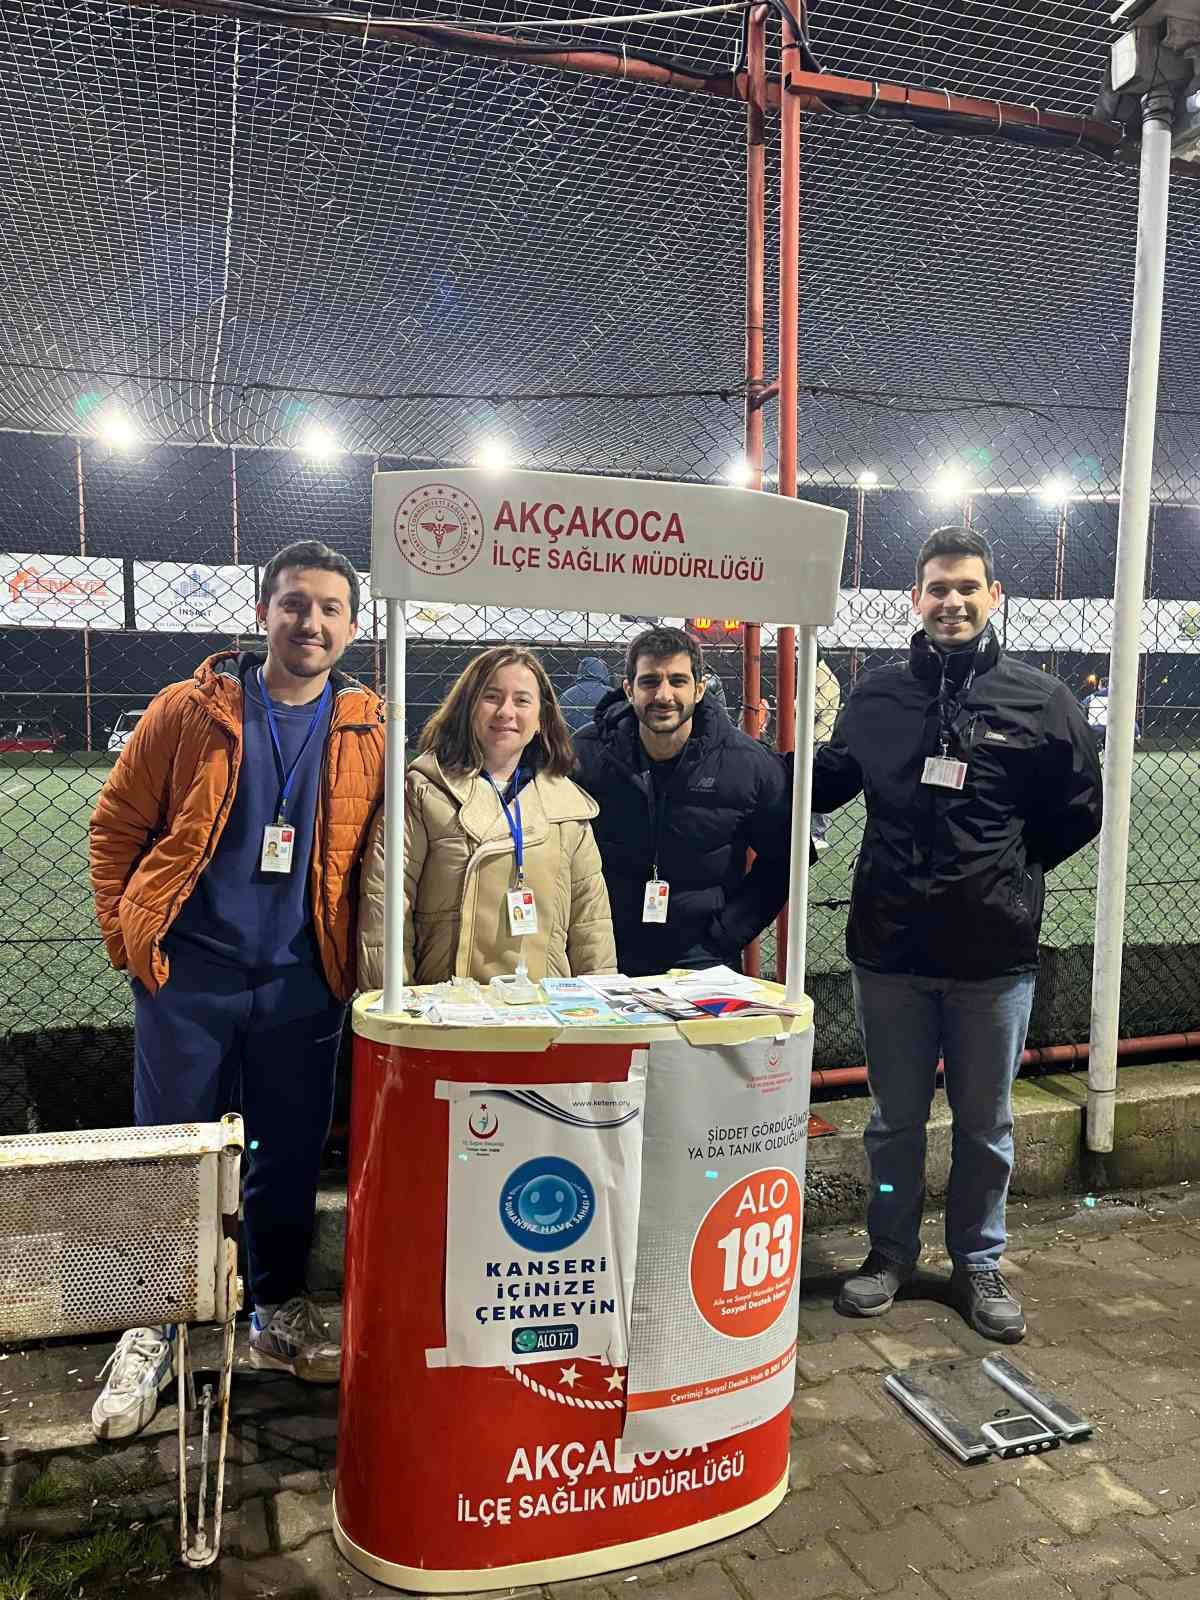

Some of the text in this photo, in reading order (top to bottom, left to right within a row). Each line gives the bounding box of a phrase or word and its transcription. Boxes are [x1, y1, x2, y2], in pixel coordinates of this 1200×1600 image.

[493, 500, 686, 544] AKÇAKOCA
[492, 540, 765, 582] İLÇE SAĞLIK MÜDÜRLÜĞÜ
[707, 1124, 748, 1145] ŞİDDET
[688, 1146, 704, 1160] YA
[708, 1147, 725, 1159] DA
[729, 1140, 762, 1157] TANIK
[735, 1178, 789, 1218] ALO
[717, 1212, 793, 1292] 183
[486, 1257, 607, 1278] KANSERİ
[497, 1280, 596, 1301] İÇİNİZE
[475, 1299, 616, 1325] ÇEKMEYİN
[721, 1301, 748, 1316] Sosyal
[537, 1331, 574, 1349] ALO 171
[506, 1437, 709, 1486] AKÇA
[457, 1450, 745, 1528] İLÇE SAĞLIK MÜDÜRLÜĞÜ
